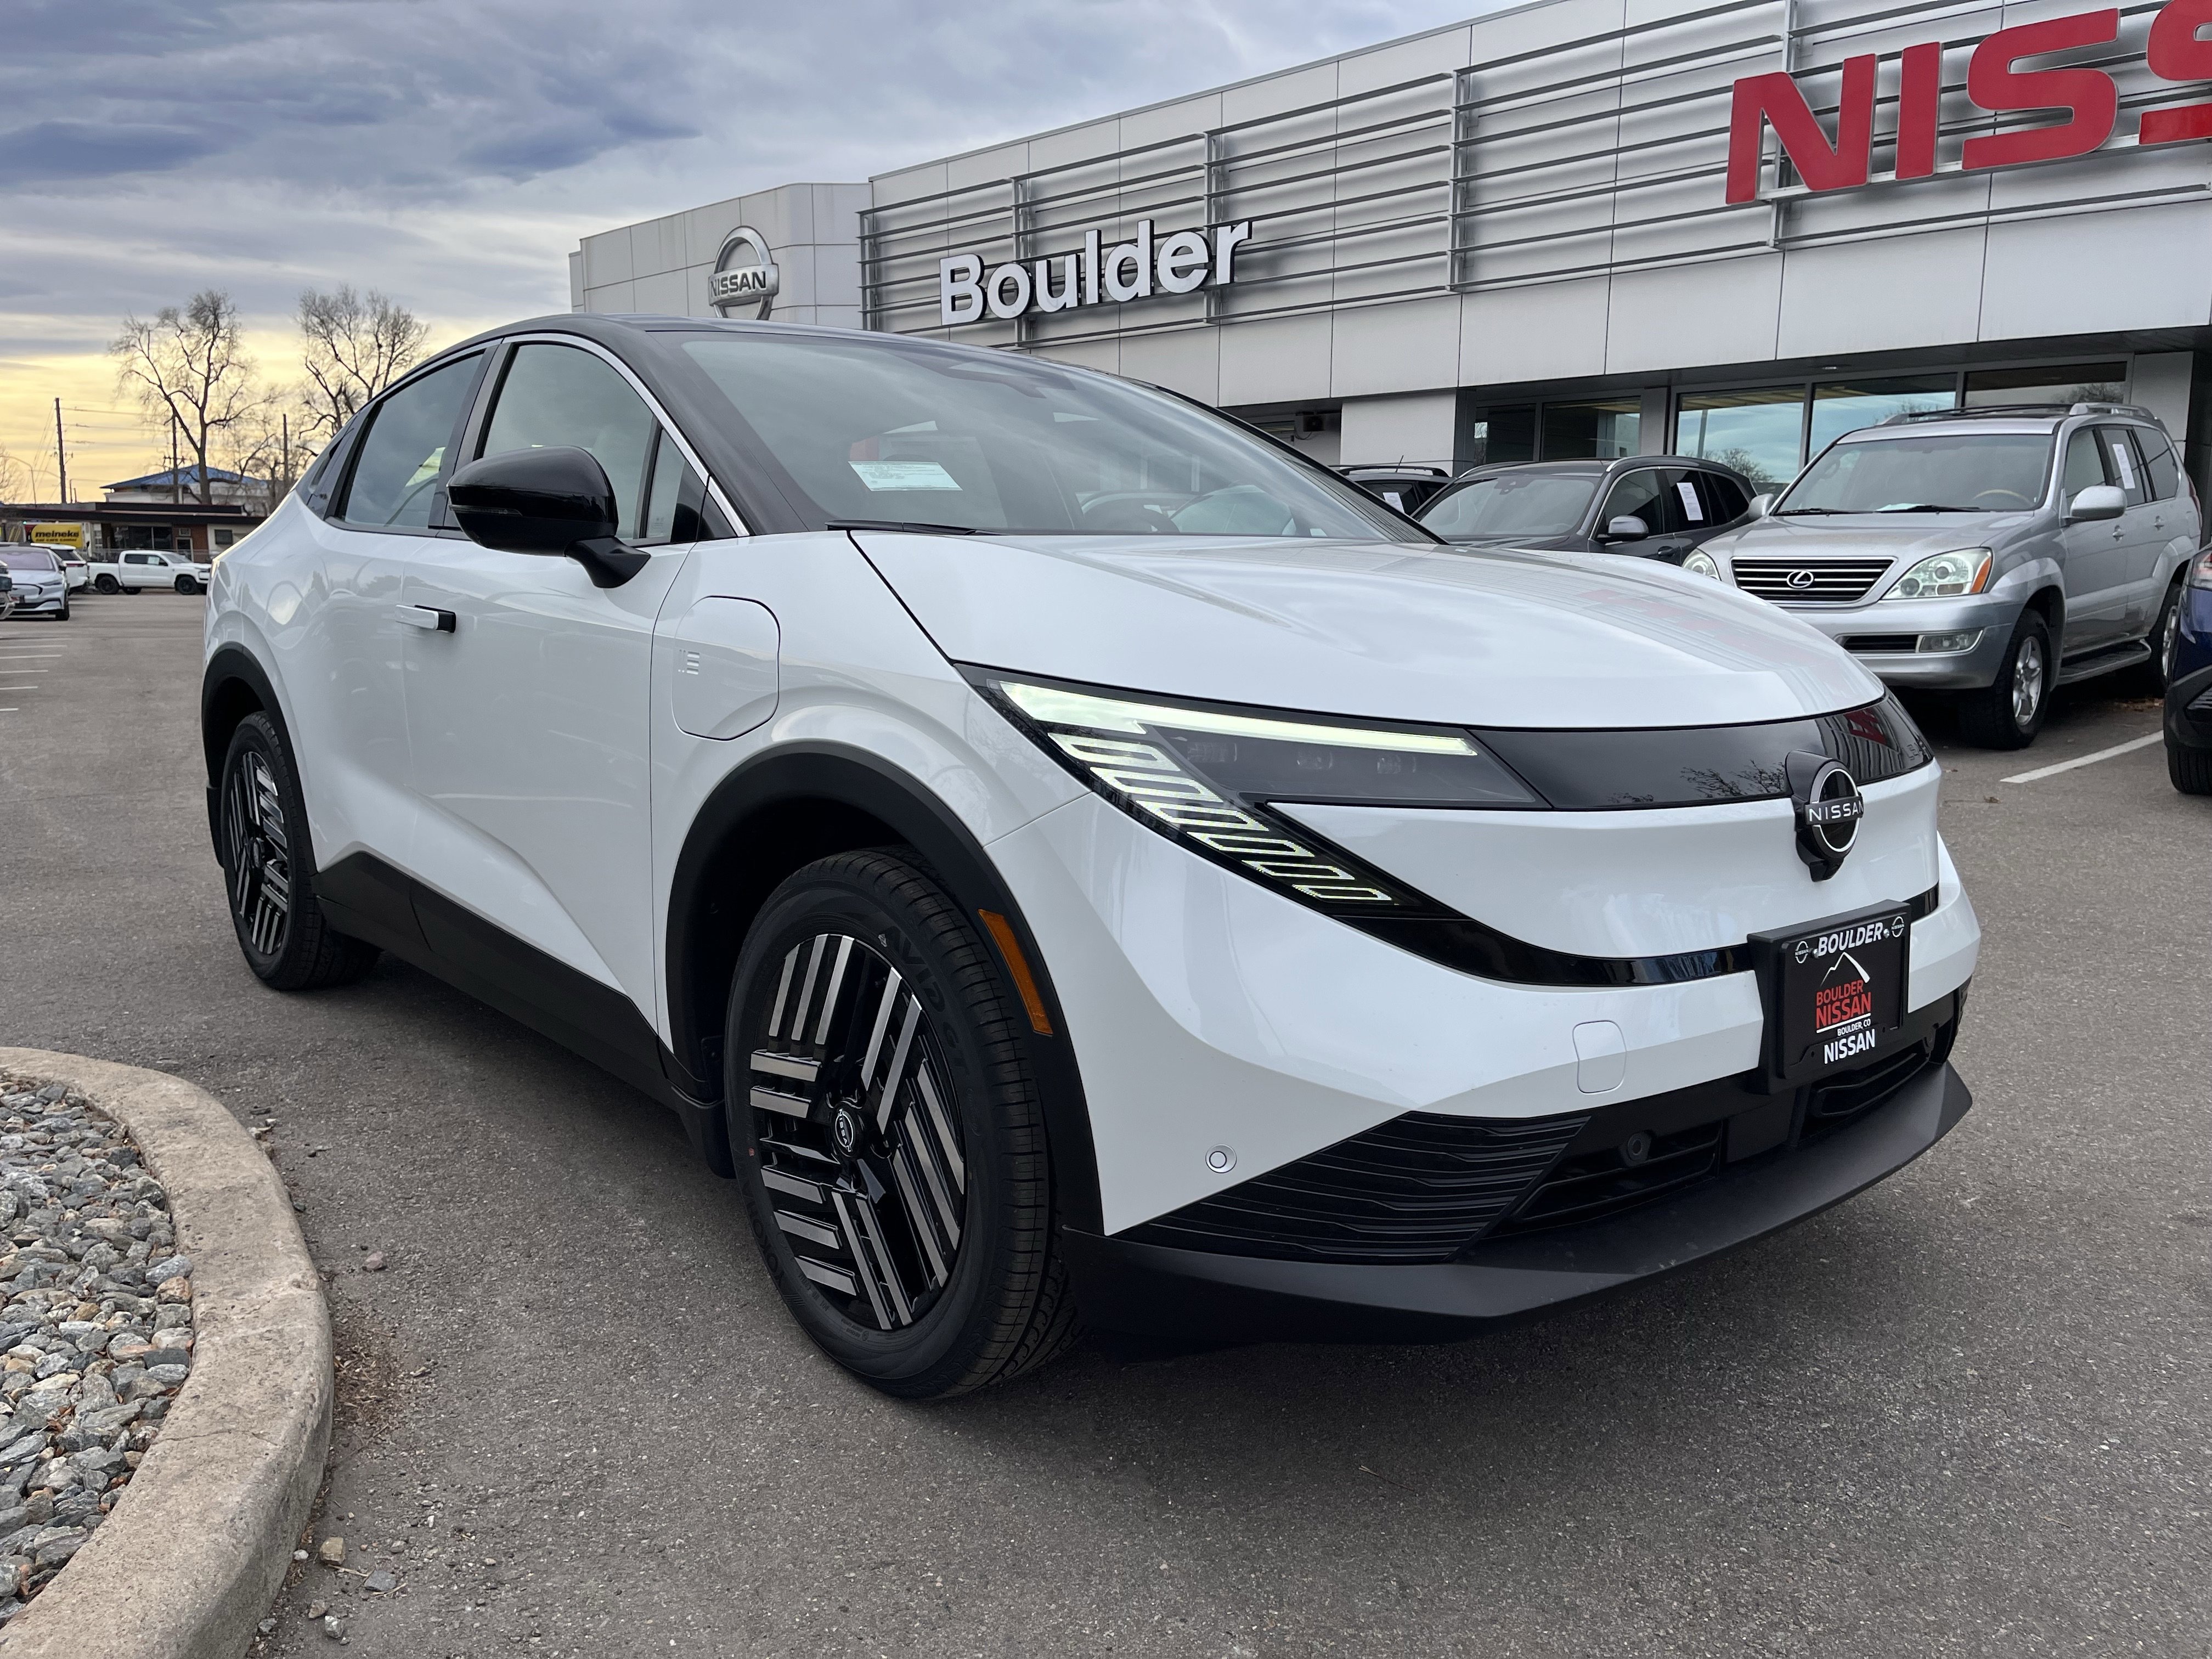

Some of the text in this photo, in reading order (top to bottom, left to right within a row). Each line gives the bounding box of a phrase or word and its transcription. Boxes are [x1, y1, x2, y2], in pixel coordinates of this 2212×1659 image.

[710, 270, 766, 298] NISSAN
[940, 219, 1251, 325] Boulder
[1809, 800, 1864, 822] NISSAN
[1818, 922, 1883, 957] BOULDER
[1816, 979, 1864, 1006] BOULDER
[1816, 992, 1871, 1029] NISSAN
[1863, 1018, 1871, 1027] CO
[1824, 1029, 1875, 1064] NISSAN
